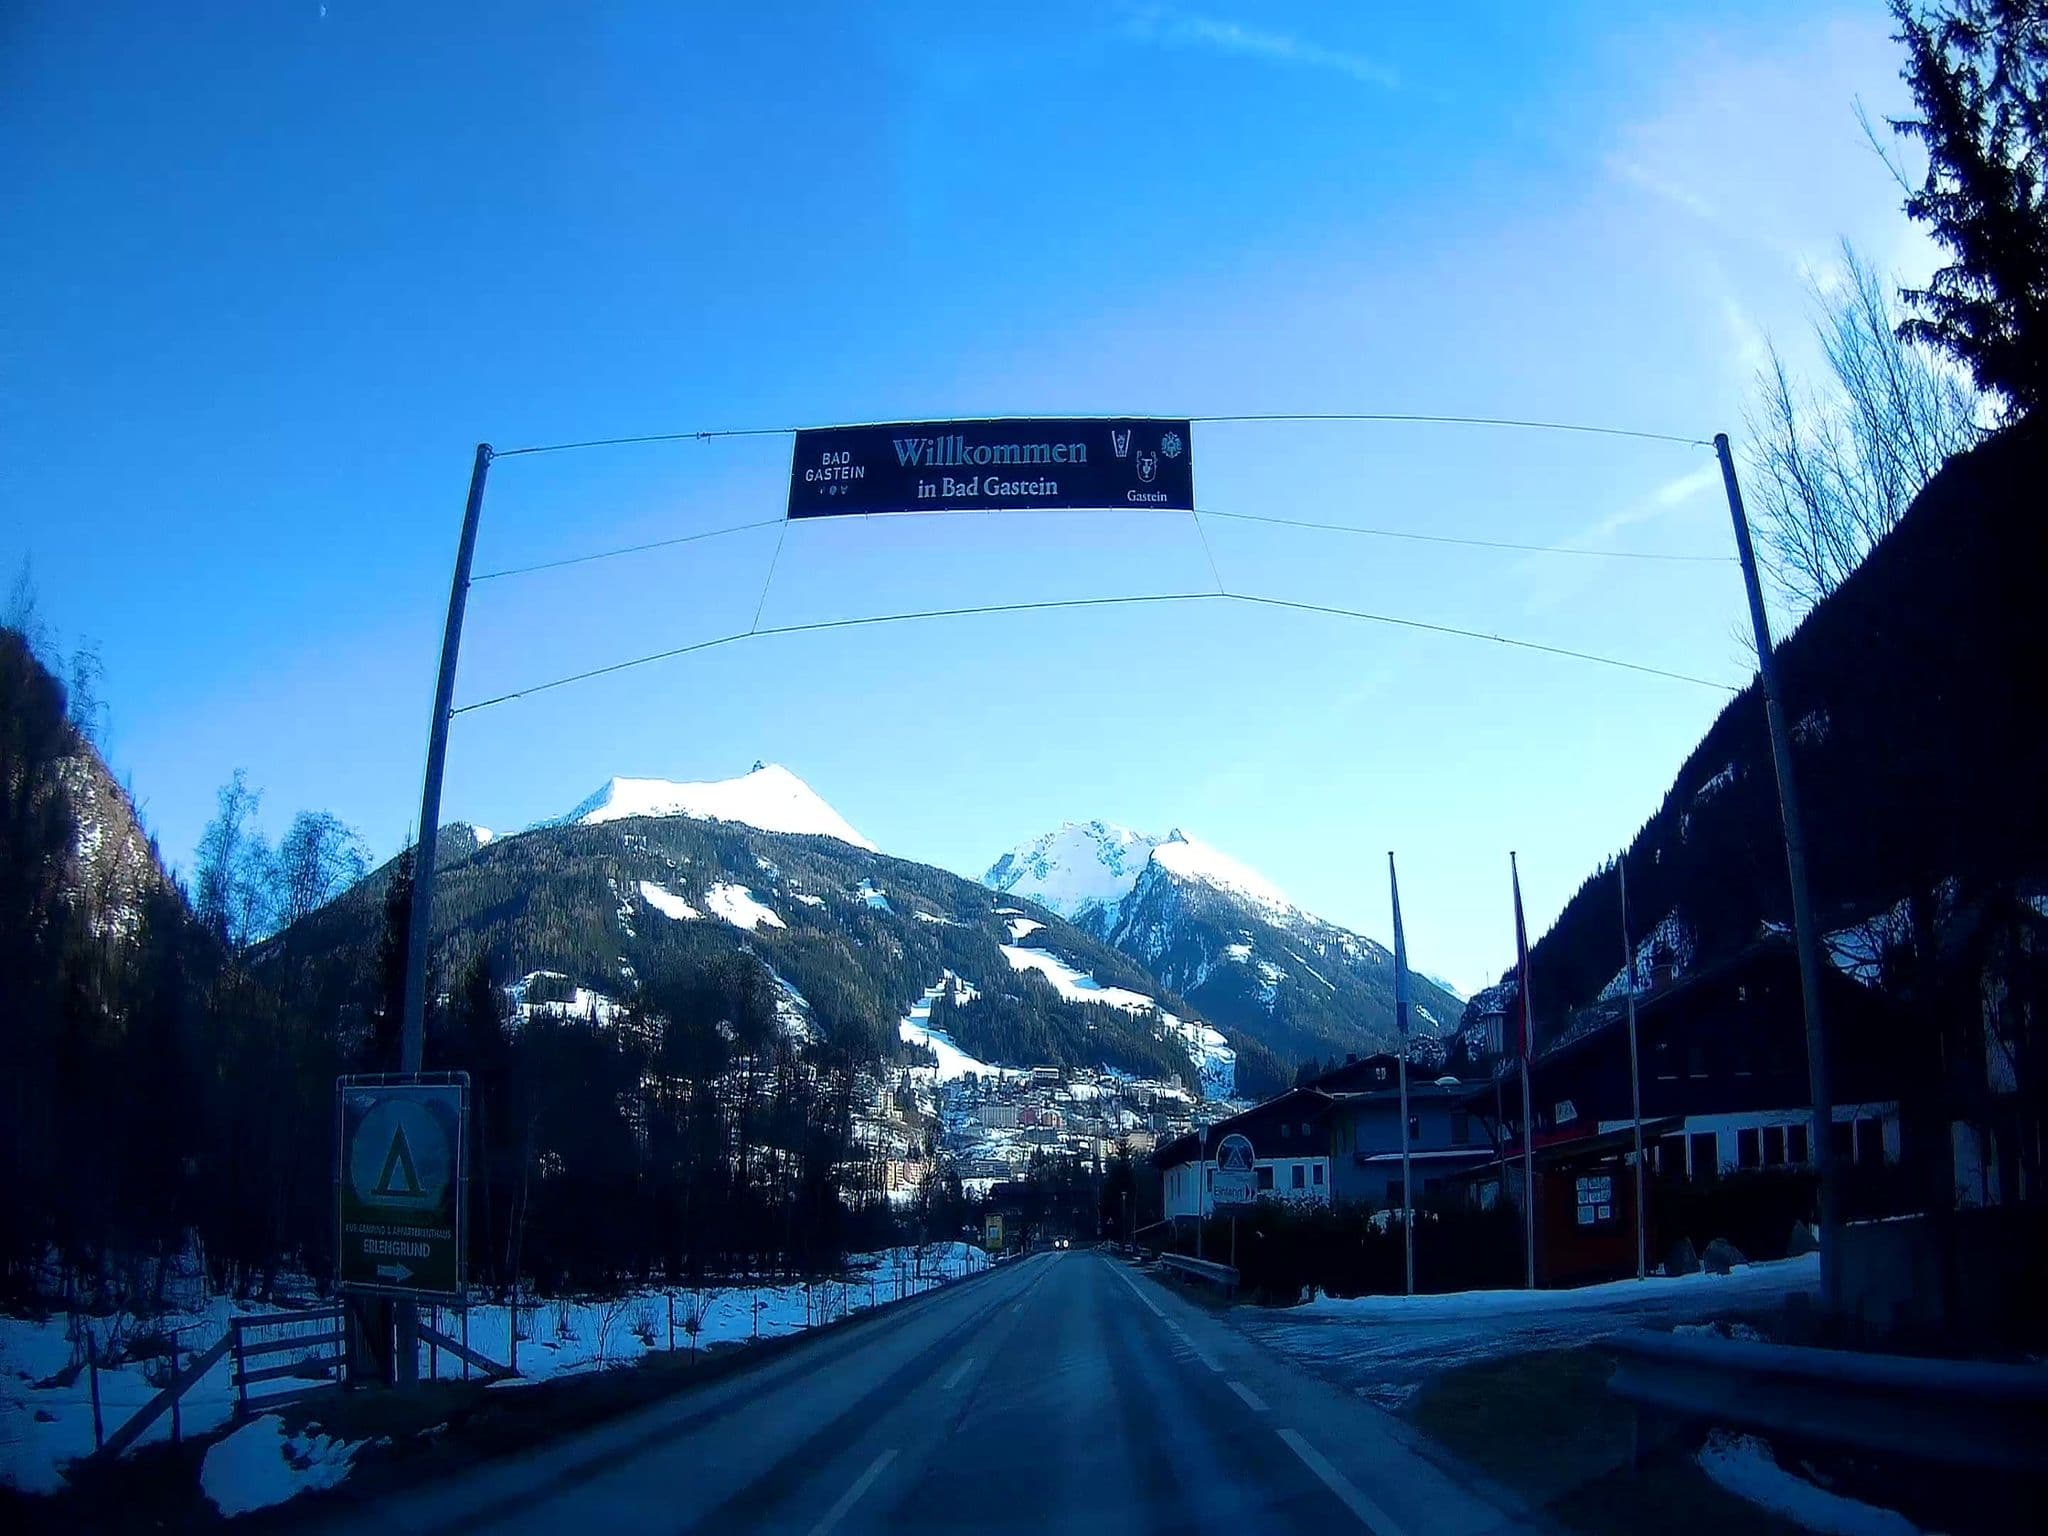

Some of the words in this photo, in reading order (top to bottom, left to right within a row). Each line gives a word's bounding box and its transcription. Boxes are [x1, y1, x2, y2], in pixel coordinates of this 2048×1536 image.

[822, 452, 851, 466] BAD
[893, 435, 1088, 466] Willkommen
[805, 466, 866, 482] GASTEIN
[917, 479, 937, 499] in
[942, 476, 979, 498] Bad
[983, 476, 1059, 497] Gastein
[1127, 490, 1168, 503] Gastein
[363, 1238, 431, 1258] ERLENGRUND
